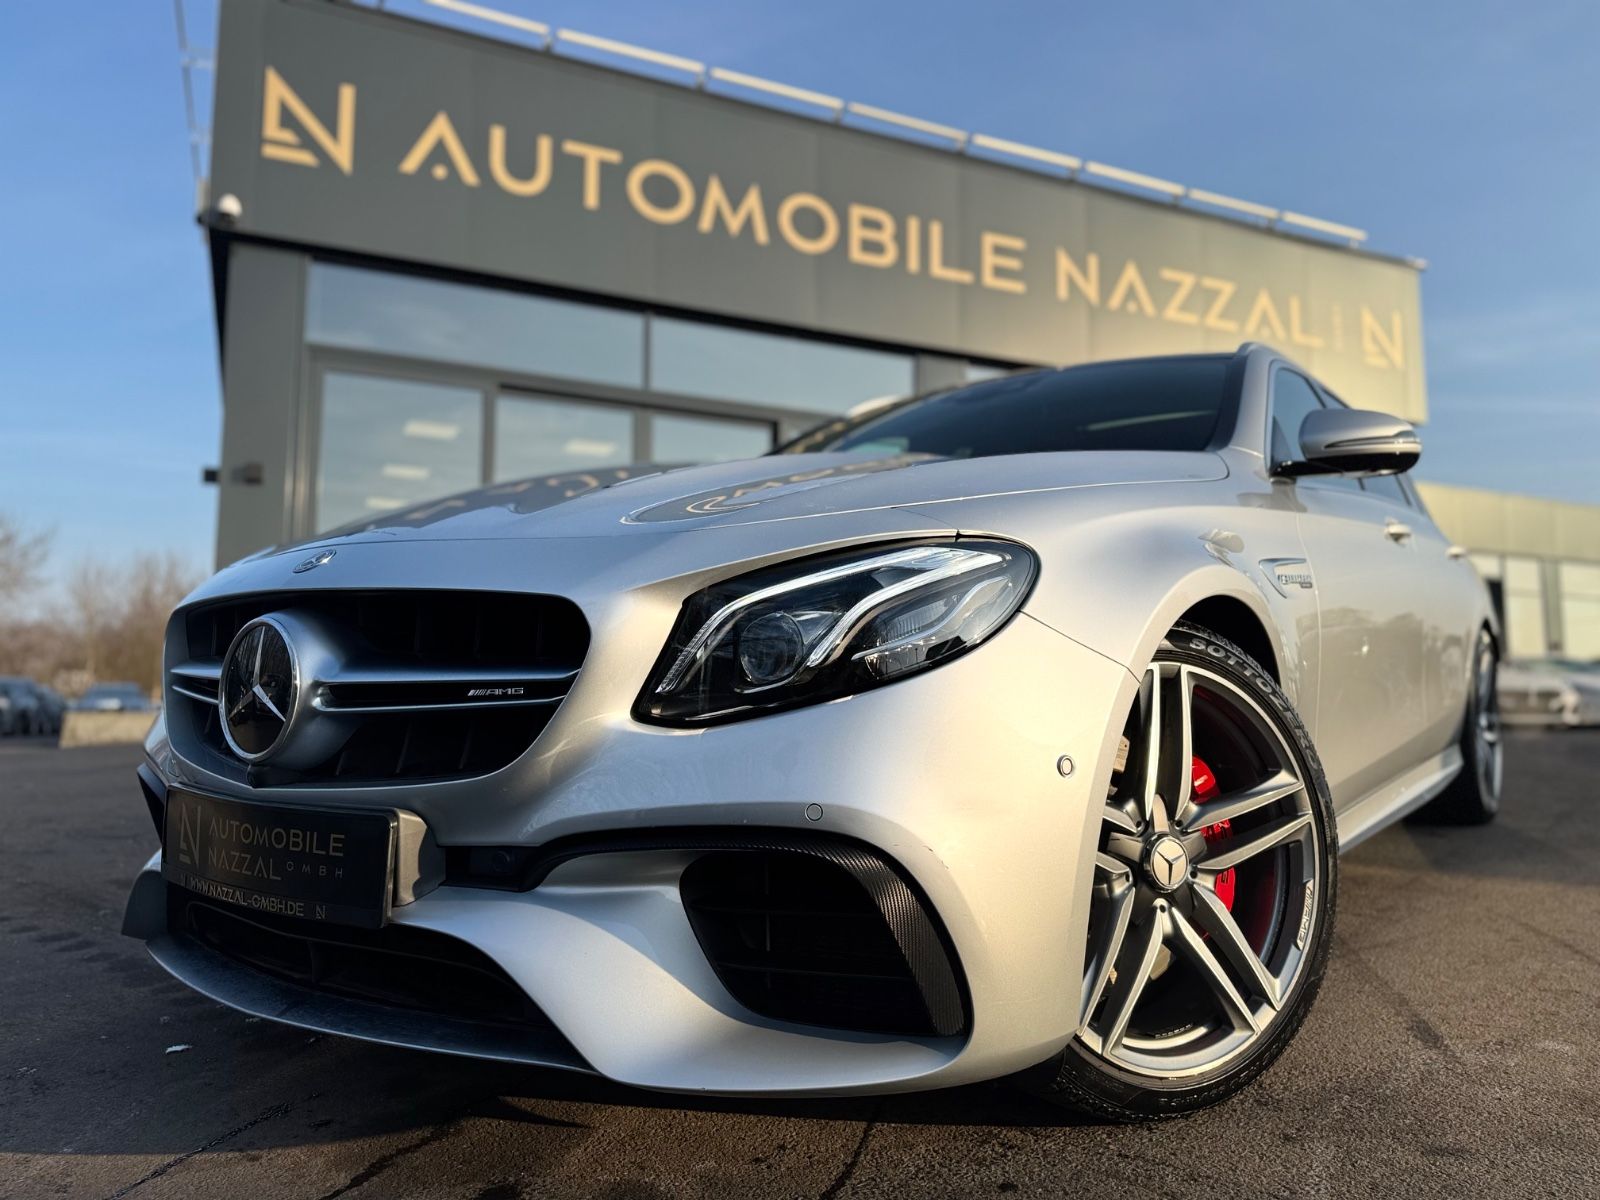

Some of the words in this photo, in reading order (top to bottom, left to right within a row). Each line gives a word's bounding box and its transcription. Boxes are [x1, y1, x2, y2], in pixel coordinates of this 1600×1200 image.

[398, 111, 1027, 294] AUTOMOBILE
[1055, 246, 1323, 348] NAZZAL
[485, 687, 524, 696] AMG
[1189, 638, 1319, 770] SOTTOZERO
[208, 817, 345, 857] AUTOMOBILE
[208, 847, 282, 880] NAZZAL
[190, 878, 305, 916] WWW.NAZZAL-GMBH.DE
